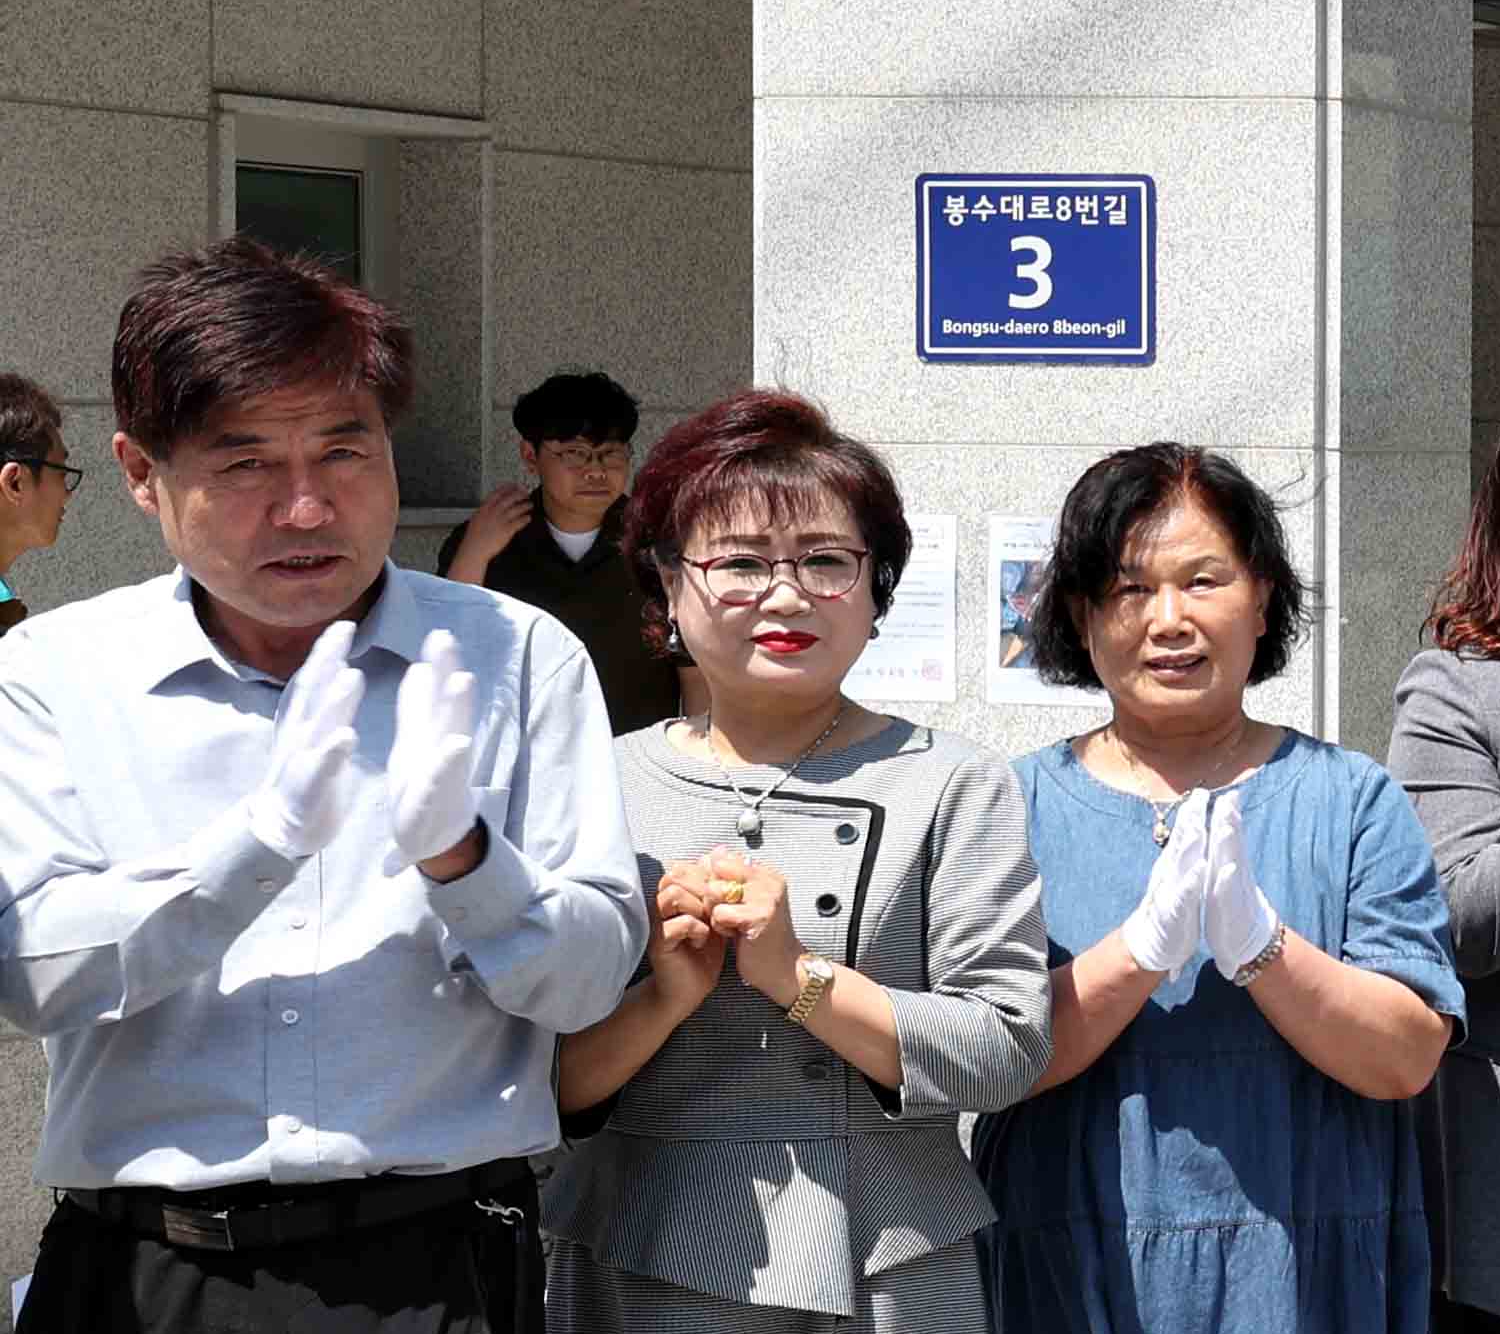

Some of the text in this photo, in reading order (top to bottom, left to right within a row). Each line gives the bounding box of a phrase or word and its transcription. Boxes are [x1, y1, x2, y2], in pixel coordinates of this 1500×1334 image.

[943, 195, 1127, 225] 봉수대로8번길
[1008, 235, 1053, 309] 3
[943, 319, 1126, 338] Bongsu-daero 8beon-gil
